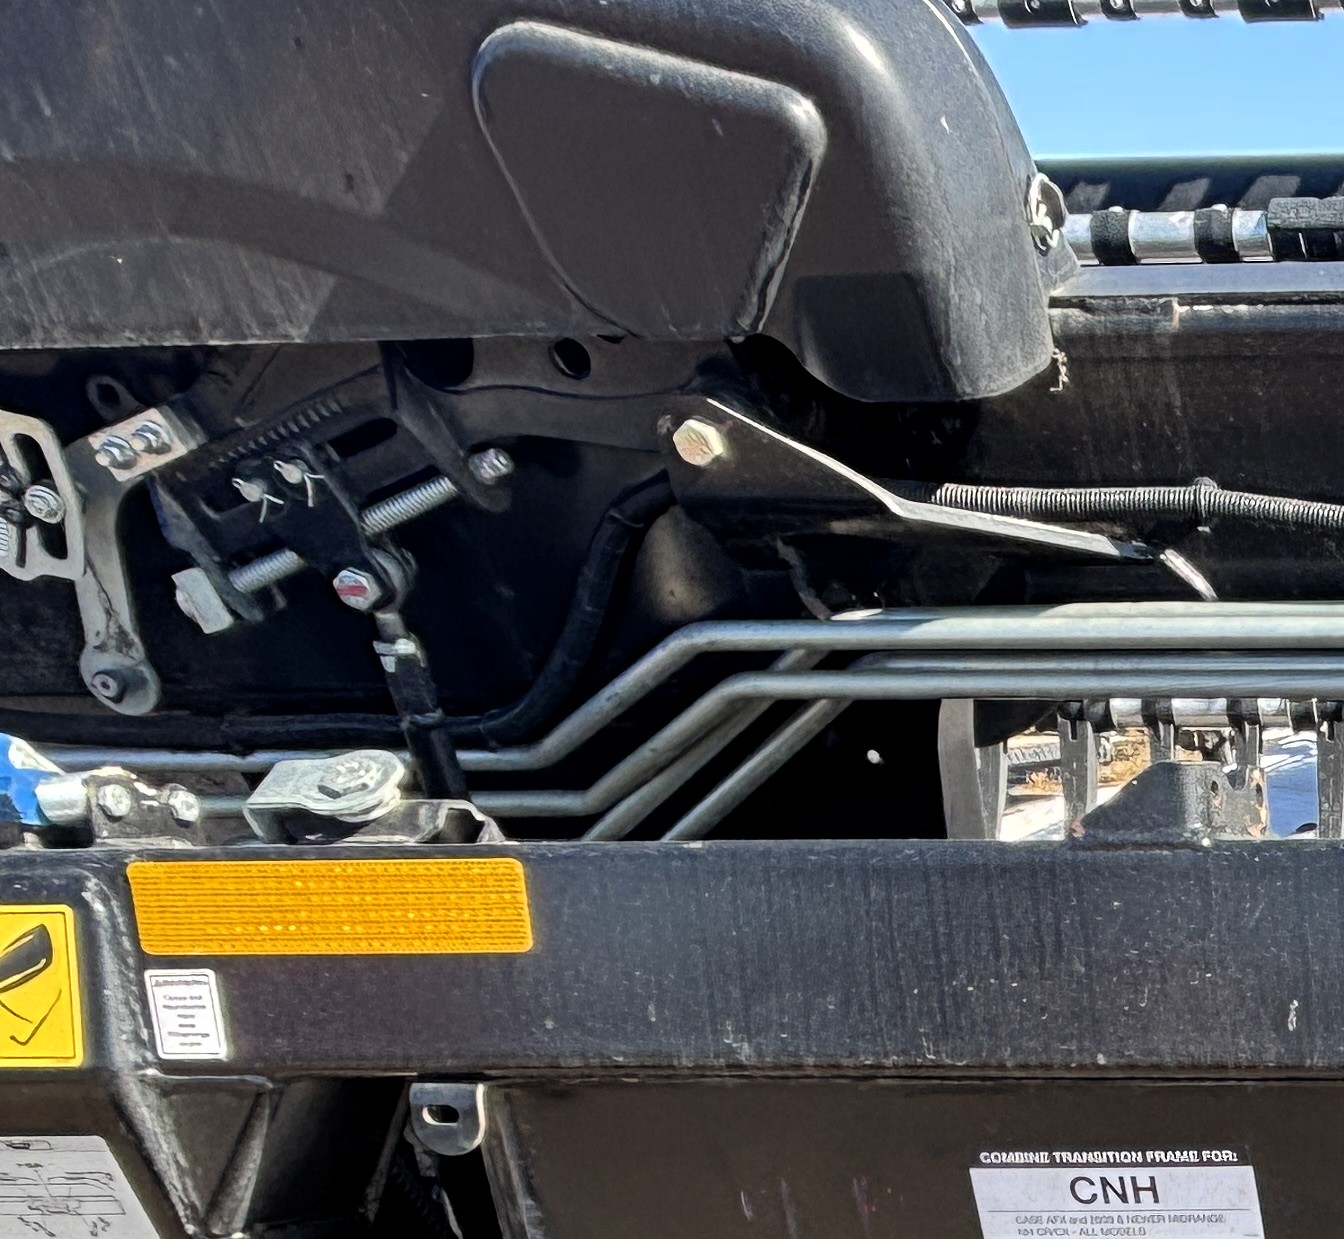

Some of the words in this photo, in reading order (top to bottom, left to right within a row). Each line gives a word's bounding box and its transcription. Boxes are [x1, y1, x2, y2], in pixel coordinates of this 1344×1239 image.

[979, 1151, 1050, 1164] COMBINE
[1052, 1150, 1143, 1164] TRANSITION
[1146, 1150, 1200, 1163] FRAME
[1069, 1175, 1160, 1205] CNH
